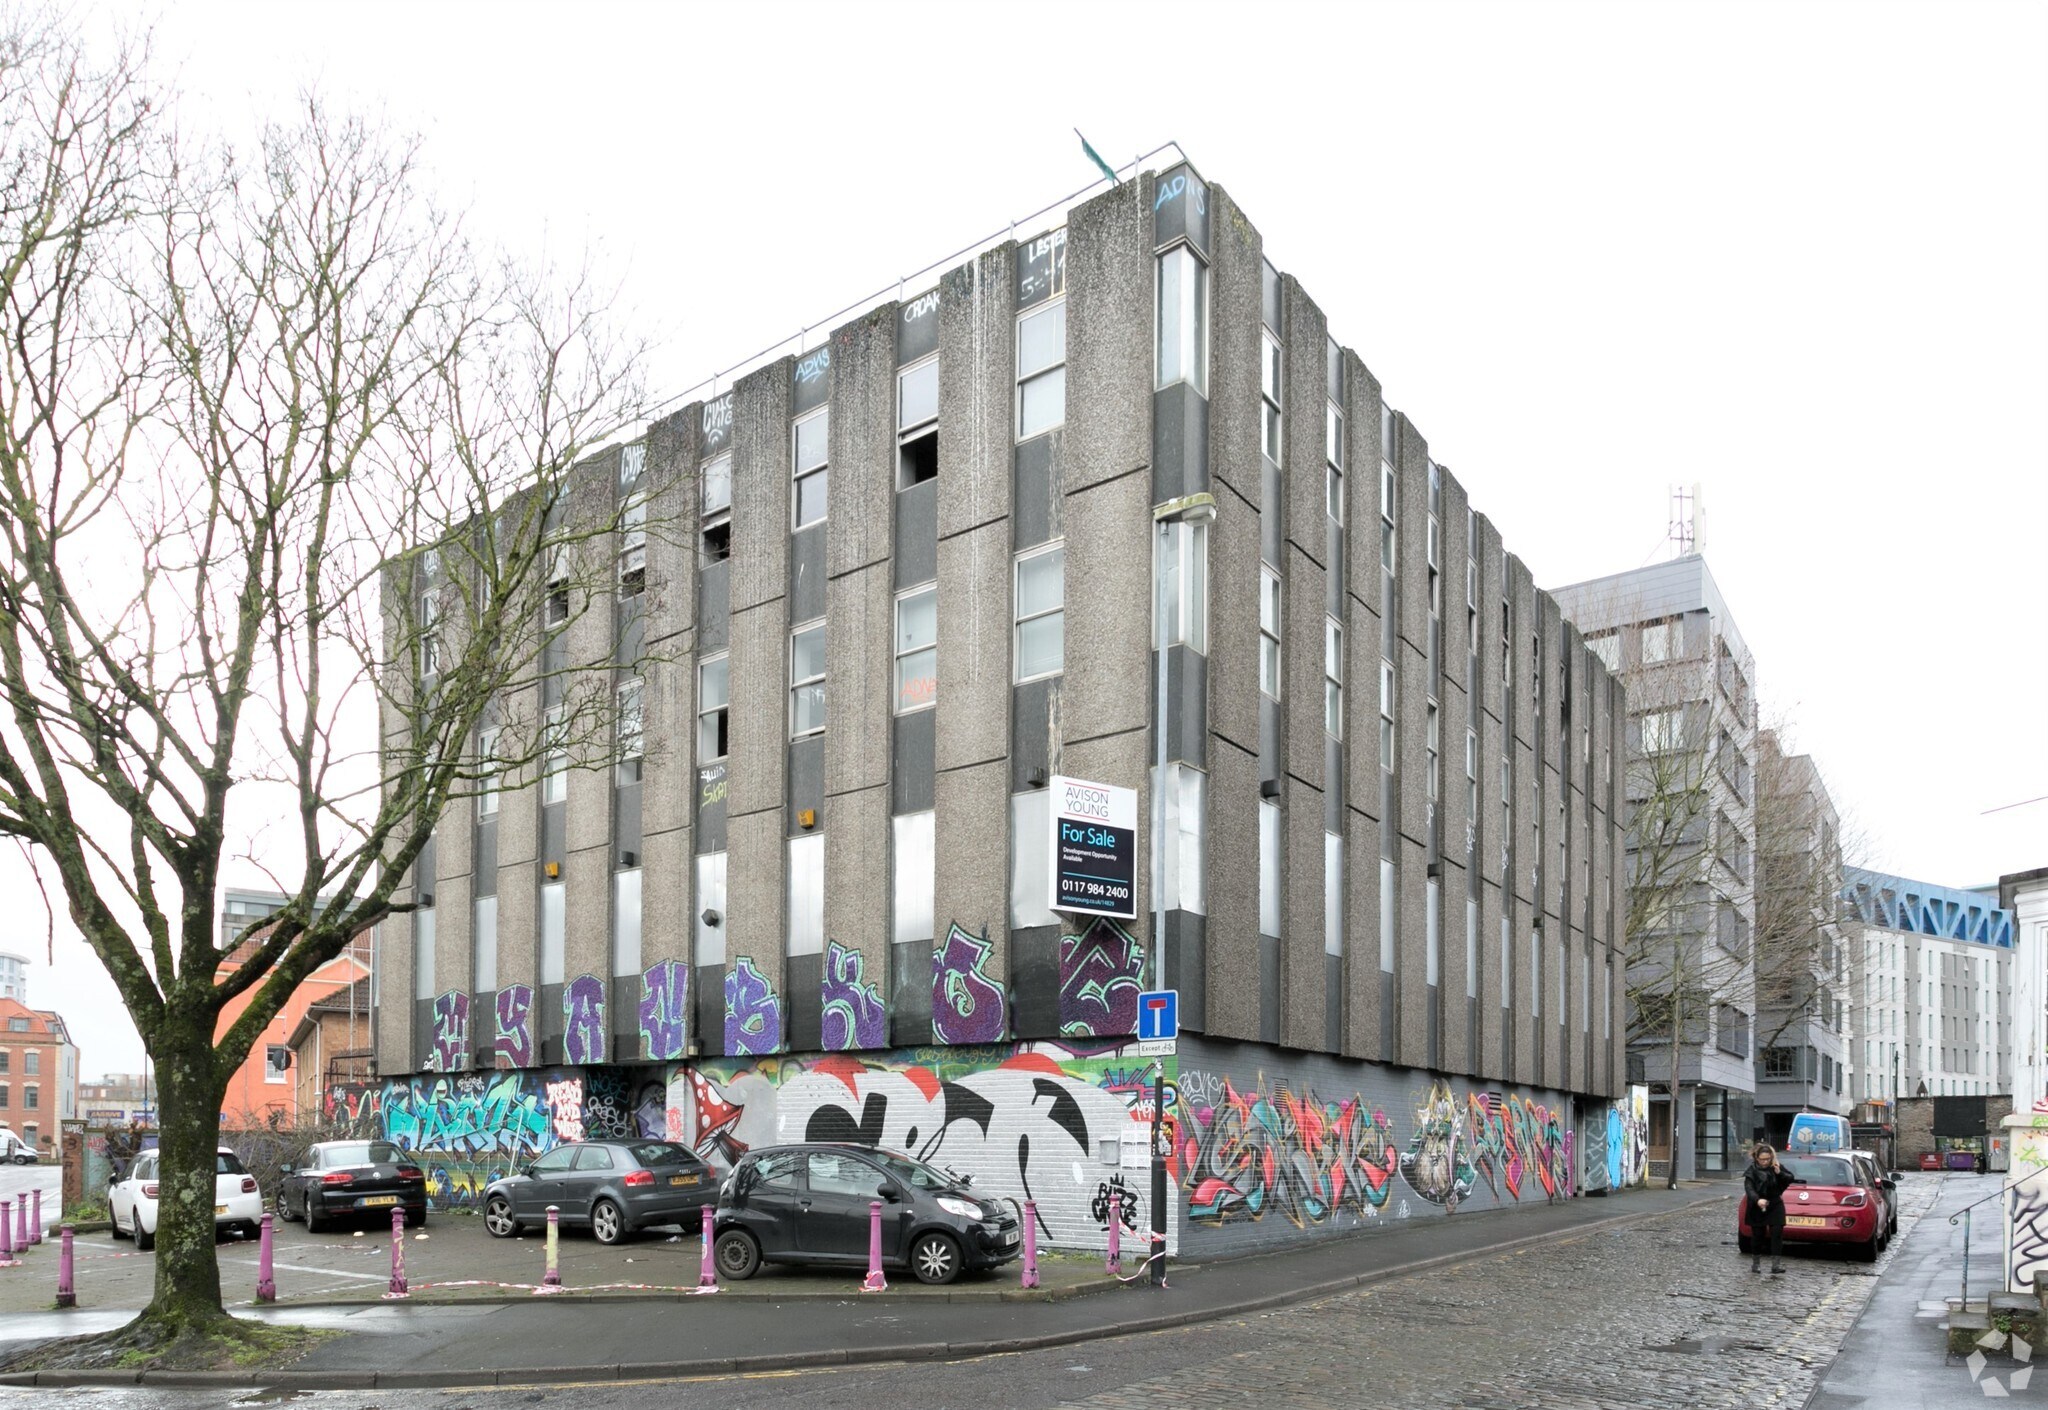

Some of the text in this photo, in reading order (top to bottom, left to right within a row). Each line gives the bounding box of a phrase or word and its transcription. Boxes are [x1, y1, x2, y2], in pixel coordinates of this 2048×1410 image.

[1066, 787, 1109, 804] AVISON
[1066, 799, 1109, 817] YOUNG
[1063, 823, 1116, 848] For Sale
[1063, 846, 1118, 861] Development Opportunity
[1063, 854, 1083, 862] Available
[1062, 880, 1129, 899] 0117 984 2400
[1141, 1045, 1161, 1053] Except
[1816, 1131, 1837, 1143] dpd
